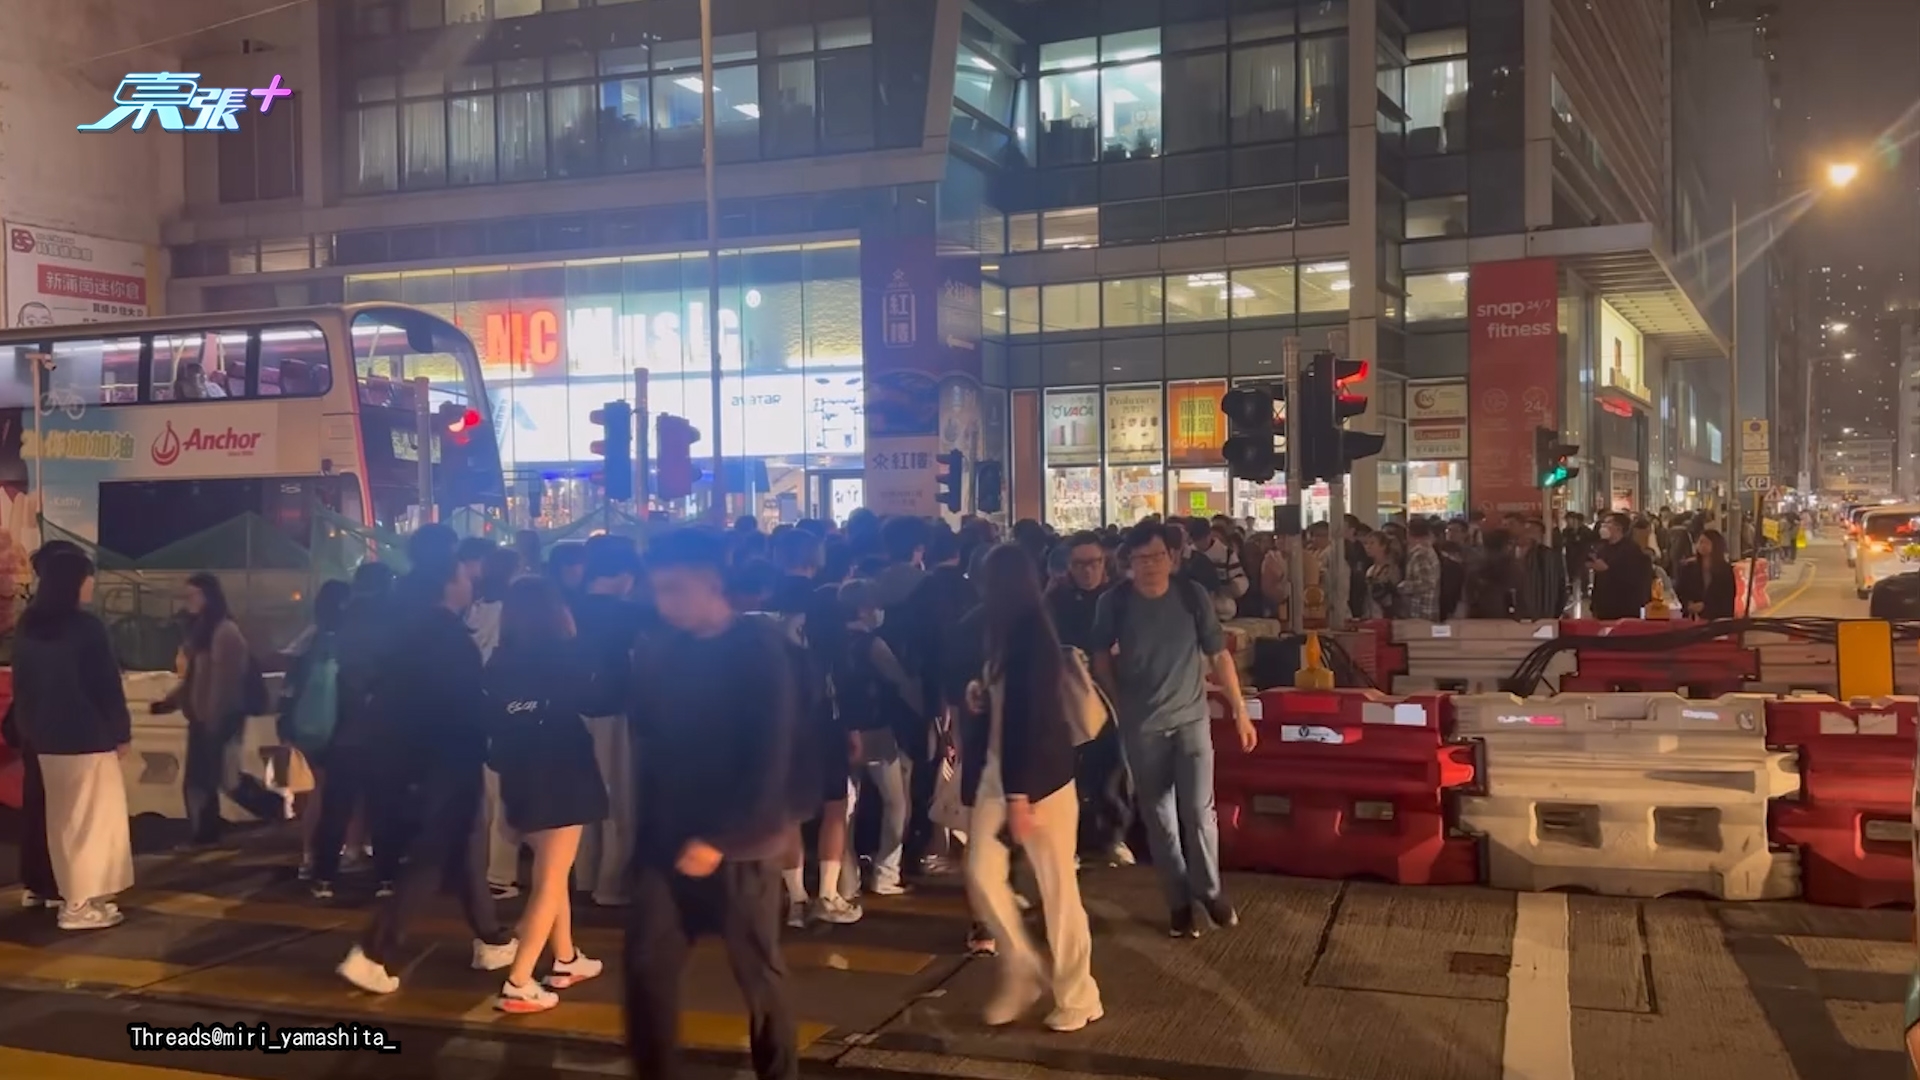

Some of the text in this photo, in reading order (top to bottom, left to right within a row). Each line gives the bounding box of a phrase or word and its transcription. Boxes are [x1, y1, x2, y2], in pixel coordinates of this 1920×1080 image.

[1476, 299, 1551, 319] snap 24/7
[1487, 322, 1551, 338] fitness
[182, 427, 262, 450] Anchor
